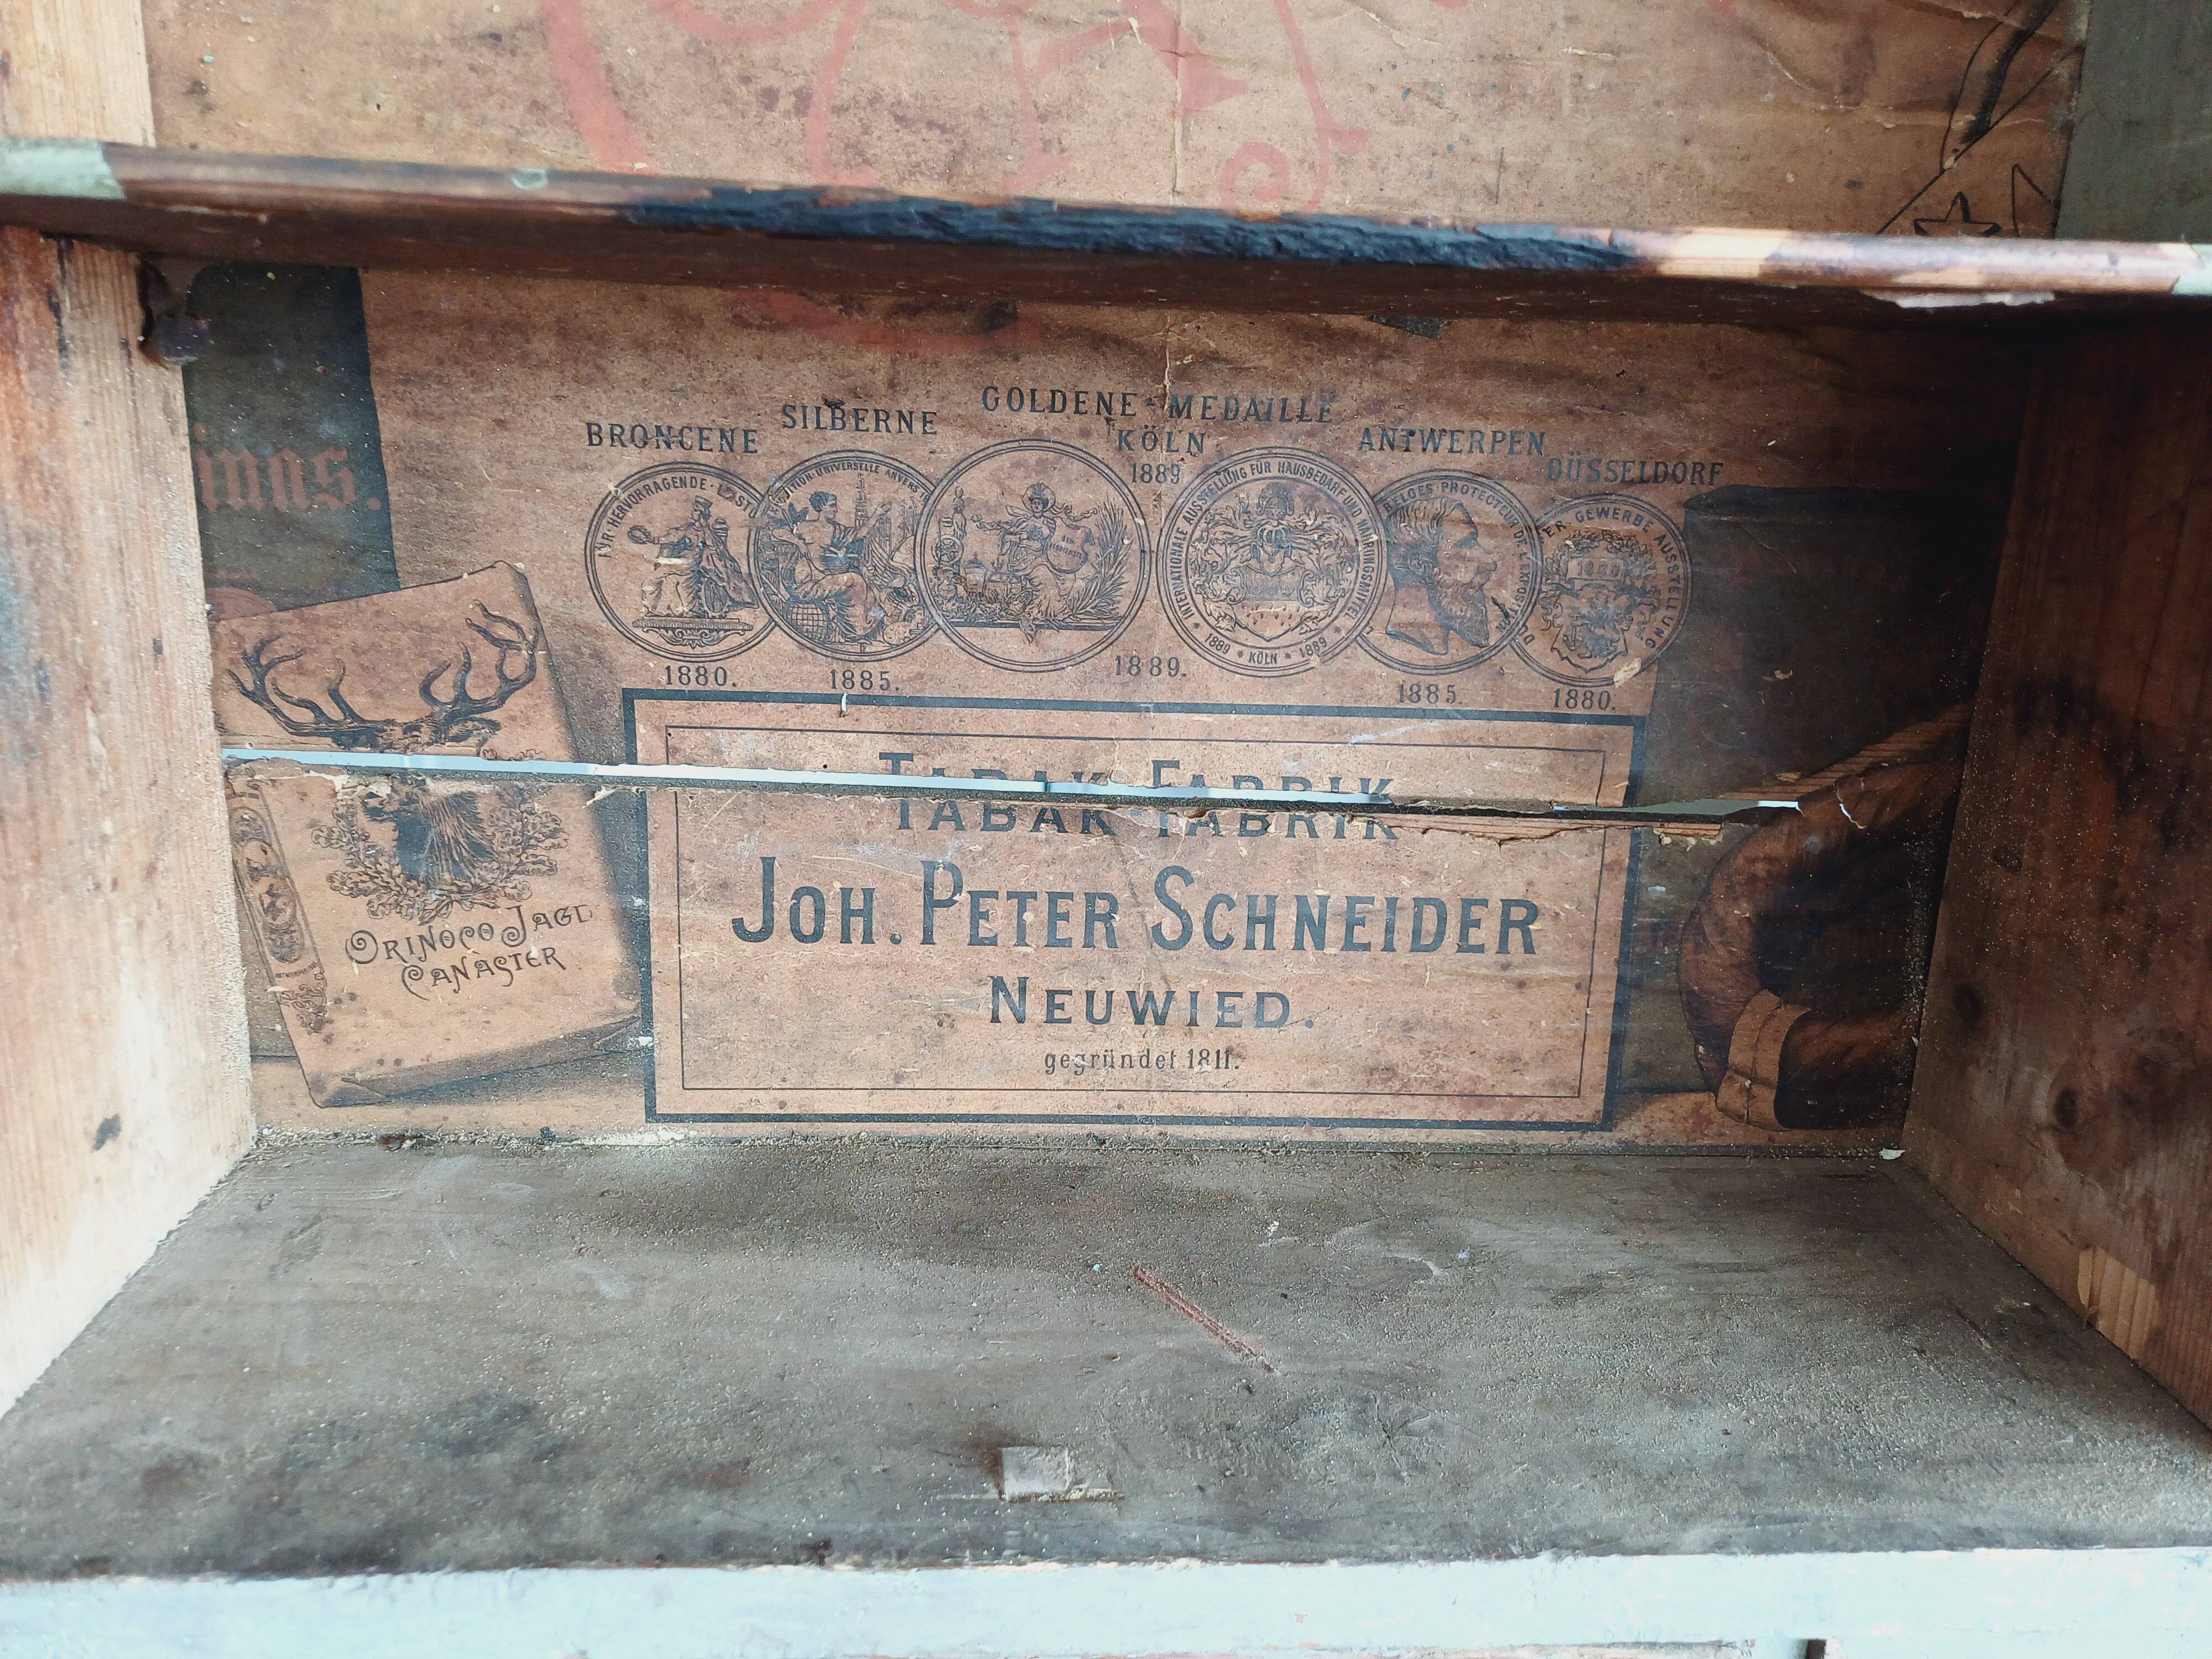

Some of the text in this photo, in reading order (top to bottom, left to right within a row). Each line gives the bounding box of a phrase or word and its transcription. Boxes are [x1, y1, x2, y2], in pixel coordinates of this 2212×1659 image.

[781, 404, 937, 435] SILBERNE
[1118, 424, 1205, 453] KÖLN
[1357, 427, 1546, 457] ANTWERPEN
[816, 462, 881, 478] UNIVERSELLE
[1132, 462, 1180, 484] 1889
[1548, 451, 1724, 486] DÜSSELDORF
[606, 476, 707, 528] HERVORRAGENDE
[1575, 507, 1655, 534] GEWERBE
[1170, 526, 1195, 620] INTERNATIONALE
[1204, 633, 1327, 664] 1889 KÖLN 1889
[665, 665, 738, 687] 1880.
[830, 669, 900, 691] 1885.
[1114, 655, 1188, 678] 1889.
[1398, 682, 1463, 705] 1885.
[1553, 689, 1616, 711] 1880.
[731, 856, 1540, 956] JOH. PETER SCHNEIDER
[345, 922, 495, 964] ORINOCO
[401, 947, 567, 1001] CANASTER
[989, 975, 1314, 1030] NEUWIED.
